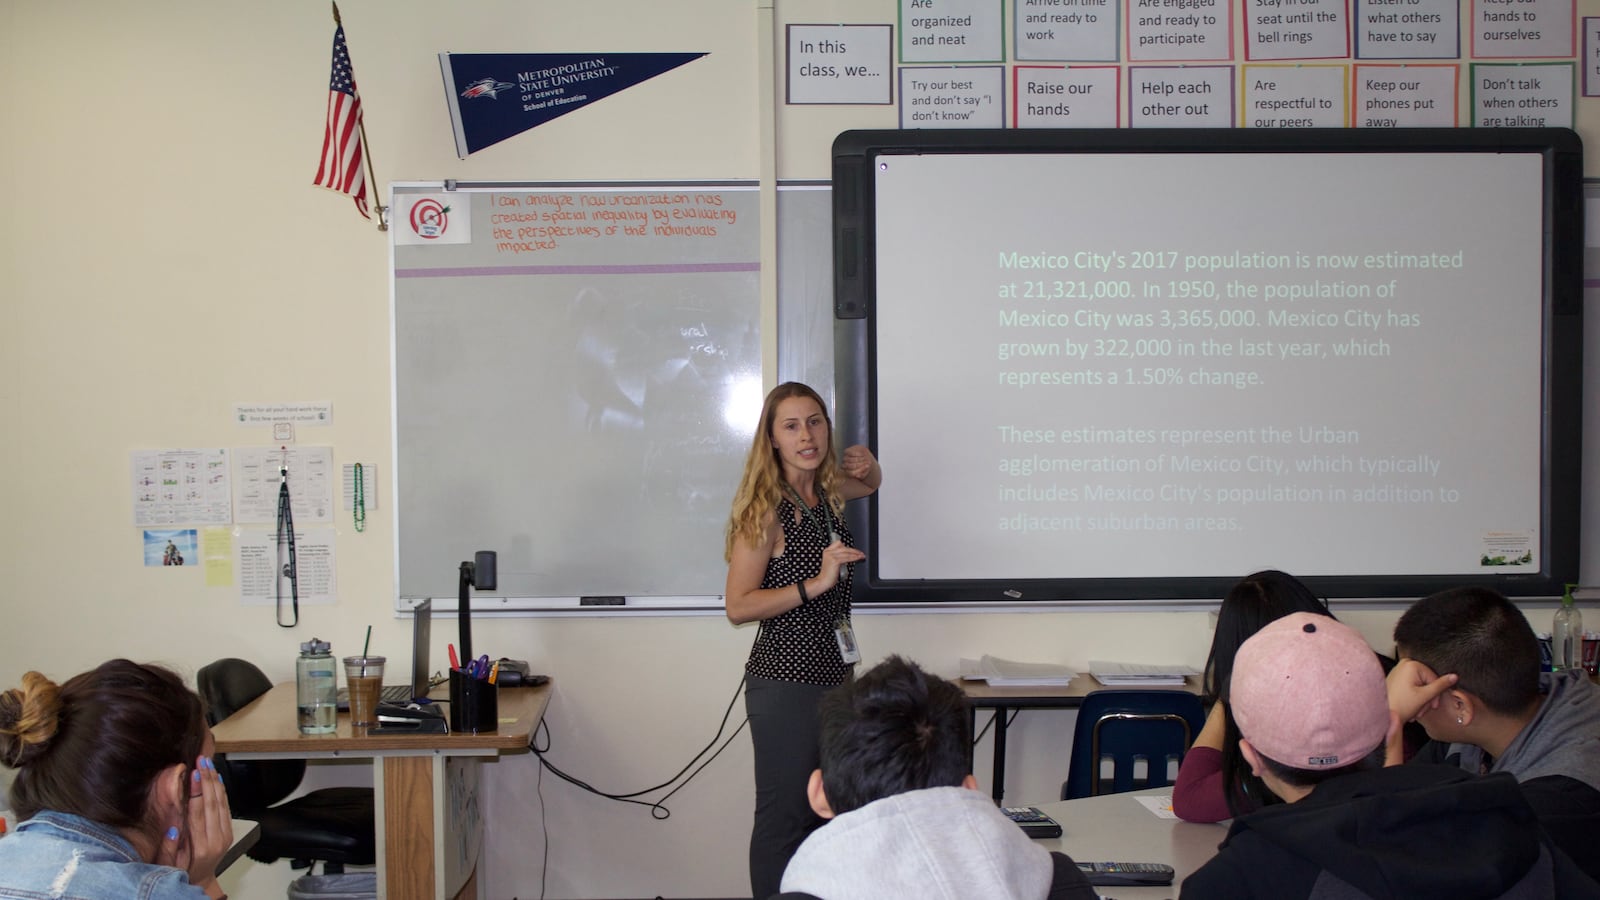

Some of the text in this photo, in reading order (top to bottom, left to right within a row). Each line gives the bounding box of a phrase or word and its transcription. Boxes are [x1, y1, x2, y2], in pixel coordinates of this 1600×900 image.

[910, 0, 933, 9] Are
[1138, 0, 1215, 10] Are engaged
[911, 15, 972, 30] organized
[1025, 11, 1098, 25] and ready to
[1138, 13, 1217, 28] and ready to
[1256, 10, 1337, 25] seat until the
[1367, 11, 1441, 24] what others
[1483, 10, 1537, 22] hands to
[911, 33, 967, 46] and neat
[1025, 28, 1055, 40] work
[1139, 32, 1206, 47] participate
[1257, 31, 1313, 45] bell rings
[1367, 30, 1437, 44] have to say
[1483, 28, 1542, 41] ourselves
[800, 39, 847, 54] In this
[517, 58, 605, 83] METROPOLITAN
[799, 62, 840, 79] class,
[519, 80, 550, 93] STATE
[911, 79, 973, 92] Try our best
[1027, 81, 1094, 95] Raise our
[1141, 80, 1212, 97] Help each
[1254, 79, 1277, 91] Are
[1366, 79, 1421, 93] Keep our
[1482, 78, 1541, 90] Don't talk
[521, 87, 565, 102] OF DENVER
[911, 95, 931, 106] and
[933, 95, 961, 106] don't
[963, 97, 981, 107] say
[523, 94, 588, 112] School of Education
[1027, 102, 1071, 116] hands
[1141, 102, 1209, 116] other out
[1255, 97, 1333, 112] respectful to
[1366, 97, 1435, 112] phones put
[1482, 96, 1559, 109] when others
[911, 110, 976, 121] don't know"
[1365, 117, 1398, 128] away
[1482, 114, 1546, 128] are talking
[1254, 118, 1314, 128] our peers
[490, 193, 495, 207] I
[498, 196, 521, 207] can
[525, 194, 574, 212] analyze
[490, 207, 737, 227] created spatial inequality by evaluating
[493, 224, 718, 241] the perspectives of the individuals
[999, 250, 1463, 273] Mexico City's 2017 population is now estimated
[999, 279, 1397, 302] at 21,321,000. In 1950, the population of
[999, 309, 1421, 331] Mexico City was 3,365,000. Mexico City has
[998, 338, 1391, 361] grown by 322,000 in the last year, which
[999, 367, 1264, 389] represents a 1.50% change.
[997, 424, 1359, 447] These estimates represent the Urban
[998, 454, 1441, 477] agglomeration of Mexico City, which typically
[999, 484, 1460, 505] includes Mexico City's population in addition to
[997, 512, 1243, 535] adjacent suburban areas.
